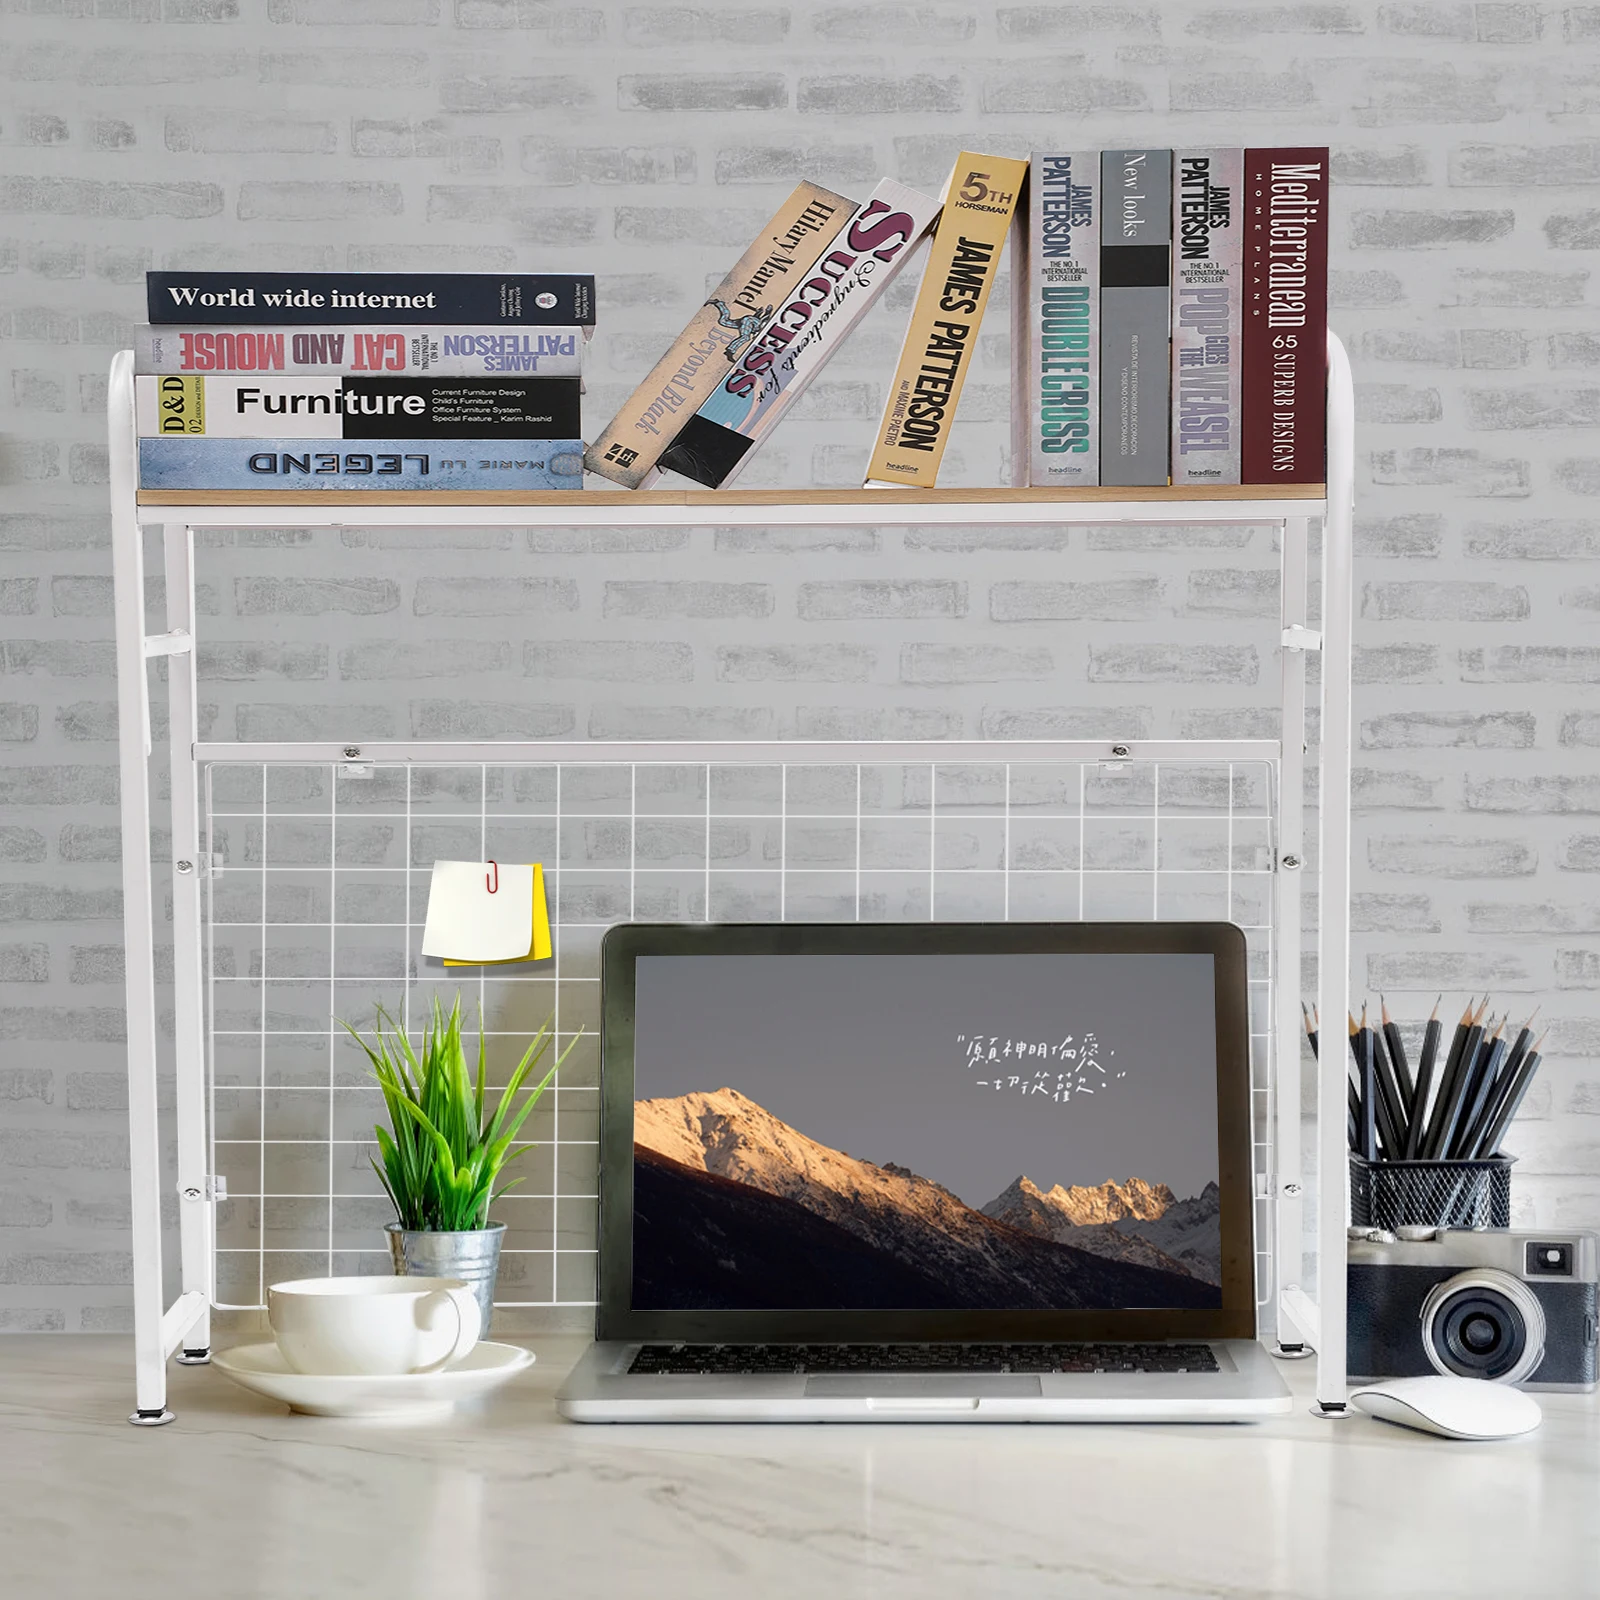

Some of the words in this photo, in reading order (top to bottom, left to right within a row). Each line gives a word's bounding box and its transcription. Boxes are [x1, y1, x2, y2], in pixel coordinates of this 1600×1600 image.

[1123, 153, 1147, 191] New
[955, 200, 1008, 216] HORSEMAN
[1042, 156, 1071, 258] PATTERSON
[1071, 184, 1092, 228] JAMES
[1123, 195, 1146, 237] looks
[1180, 157, 1210, 260] PATTERSON
[1209, 185, 1230, 229] JAMES
[1254, 173, 1263, 231] HOME
[772, 199, 836, 254] Hilary
[1268, 162, 1321, 328] Mediterranean
[733, 250, 796, 312] Mantel
[939, 236, 994, 315] JAMES
[1041, 267, 1088, 275] INTERNATIONAL
[1180, 269, 1230, 277] INTERNATIONAL
[1253, 246, 1261, 317] PLANS
[168, 286, 258, 308] World
[263, 288, 327, 308] wide
[332, 288, 437, 310] internet
[1180, 288, 1229, 335] POP
[781, 260, 876, 371] Ingredients
[179, 332, 285, 370] MOUSE
[292, 333, 345, 365] AND
[351, 333, 406, 371] CAT
[411, 338, 420, 366] BESTSELLER
[421, 333, 429, 370] INTERNATIONAL
[430, 342, 438, 351] THE
[443, 335, 575, 356] PATTERSON
[671, 326, 738, 391] Beyond
[1180, 346, 1204, 366] THE
[1205, 335, 1230, 365] GOES
[1271, 335, 1298, 349] 65
[483, 356, 539, 371] JAMES
[1131, 360, 1138, 369] DE
[1272, 353, 1296, 406] SUPERB
[236, 387, 426, 415] Furniture
[498, 389, 526, 397] Design
[757, 368, 781, 402] for
[898, 320, 971, 453] PATTERSON
[901, 380, 910, 391] AND
[634, 385, 687, 435] Black
[892, 391, 910, 418] MAXINE
[1180, 365, 1230, 455] WEASEL
[189, 419, 202, 433] 02
[884, 419, 902, 447] PAETRO
[1271, 411, 1295, 472] DESIGNS
[250, 453, 429, 475] LEGEND
[441, 459, 467, 470] LU
[479, 459, 545, 470] MARIE
[886, 461, 919, 473] headline
[1187, 468, 1222, 477] headline
